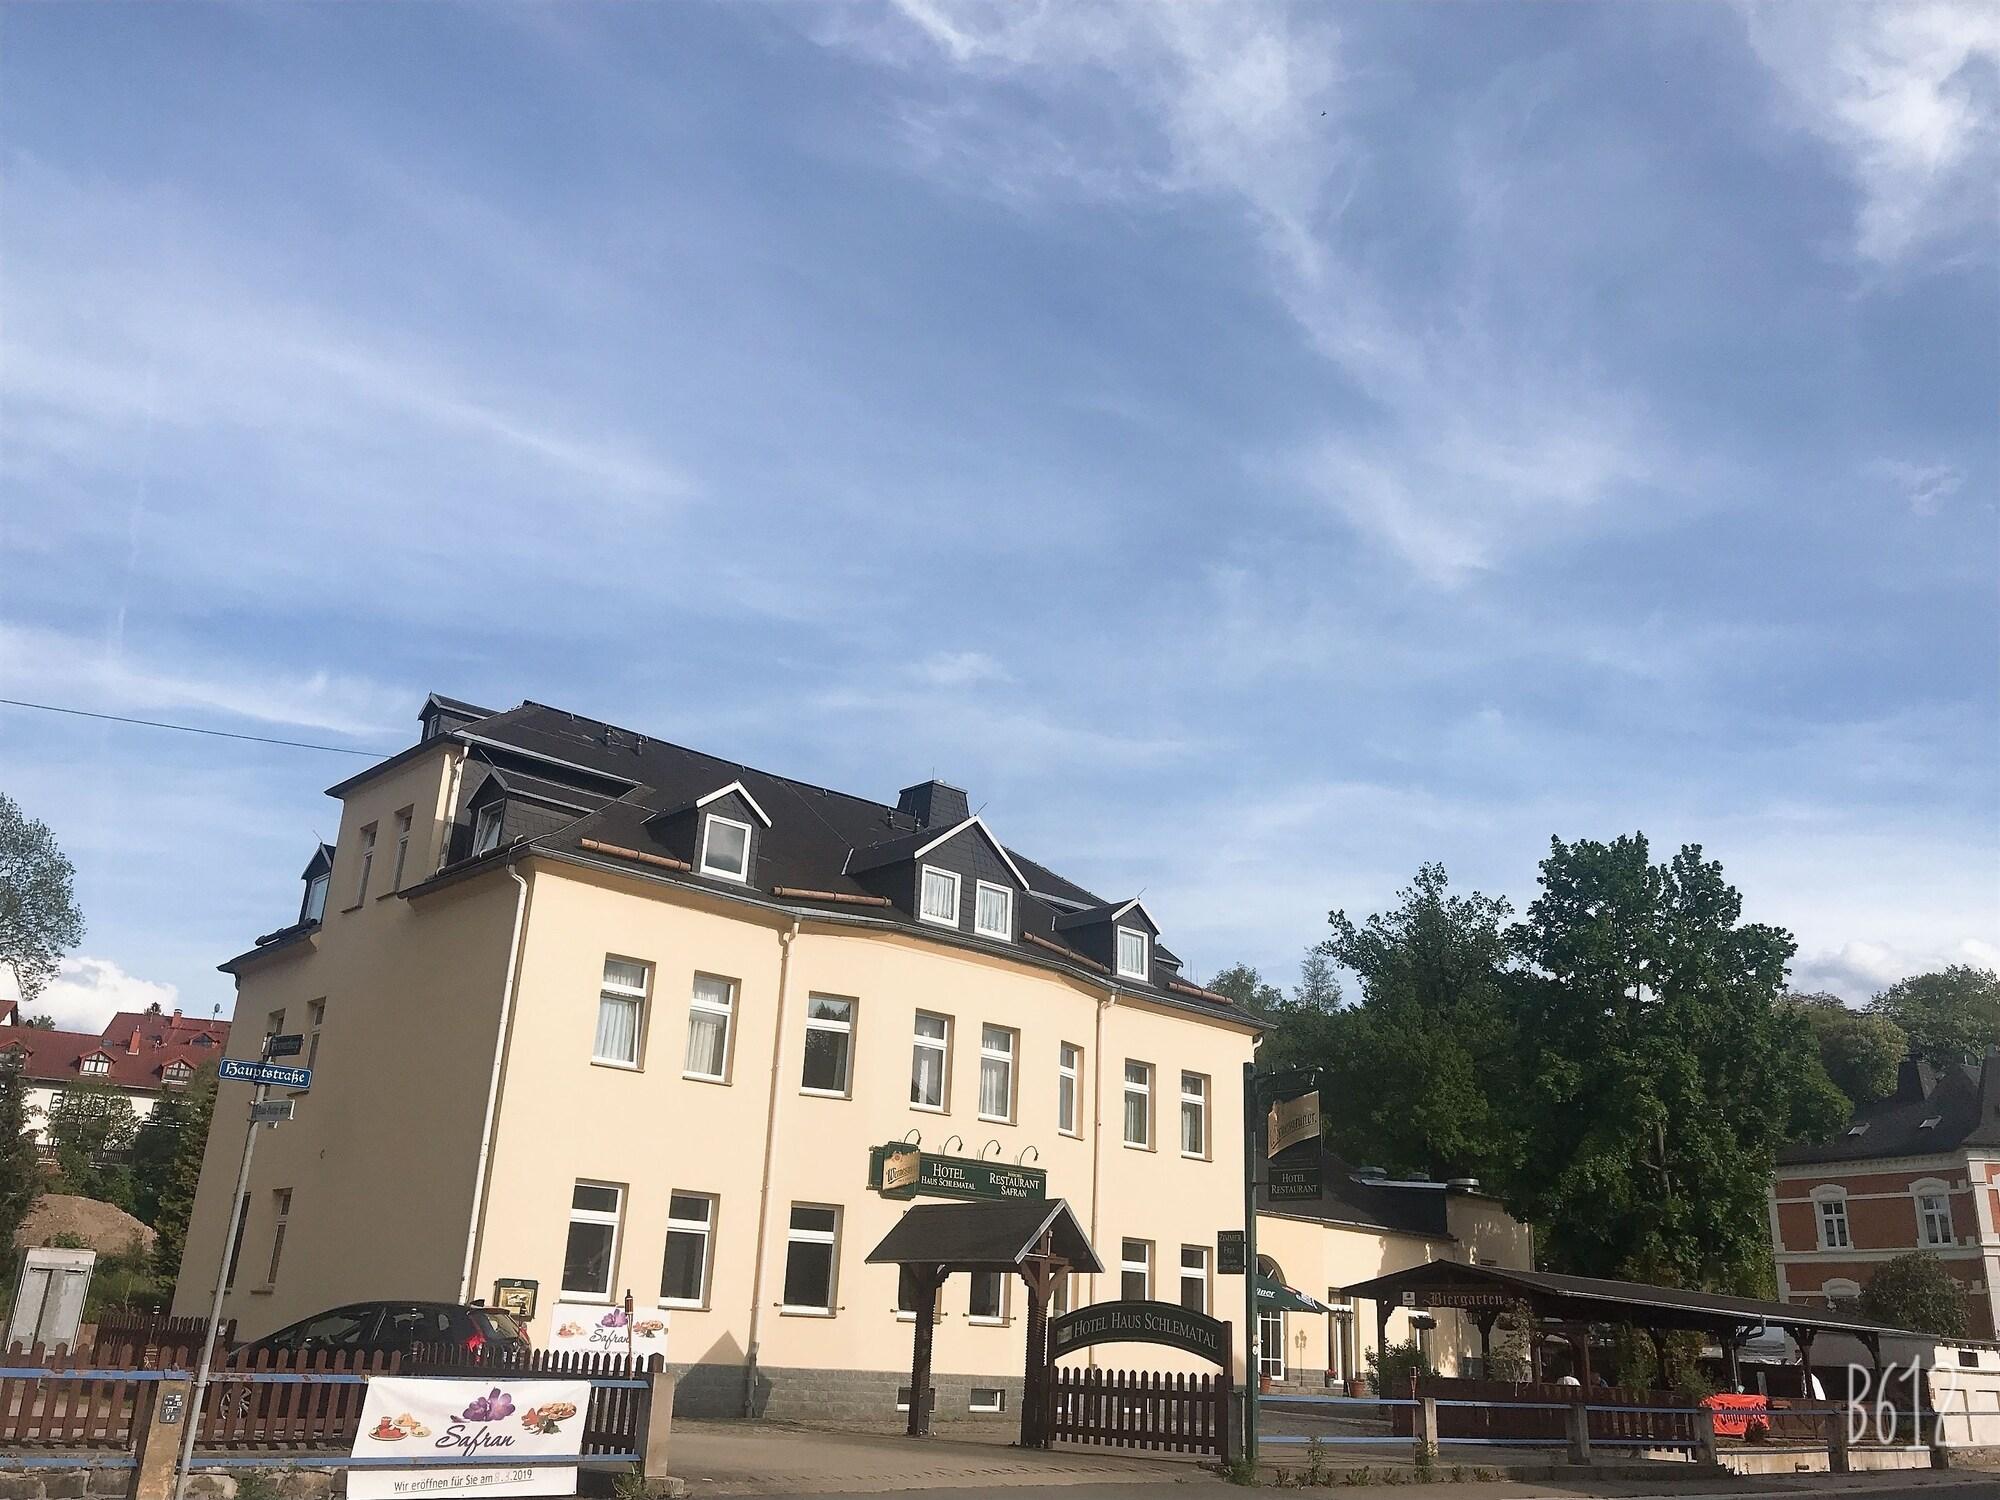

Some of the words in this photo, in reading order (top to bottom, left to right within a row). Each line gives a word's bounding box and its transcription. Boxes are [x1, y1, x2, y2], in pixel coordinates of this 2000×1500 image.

[225, 1062, 305, 1083] Hauptstraße
[932, 1163, 966, 1180] HOTEL
[1282, 1173, 1305, 1183] HOTEL
[989, 1172, 1040, 1190] RESTAURANT
[1271, 1184, 1318, 1195] RESTAURANT
[1000, 1185, 1028, 1198] SAFRAN
[1424, 1292, 1504, 1306] Biergarten
[1073, 1317, 1108, 1338] HOTEL
[1111, 1312, 1141, 1329] HAUS
[1144, 1313, 1218, 1349] SCHLEMATAL
[435, 1424, 516, 1456] Safran
[394, 1481, 409, 1492] Wir
[411, 1478, 448, 1491] eröffnen
[451, 1475, 463, 1486] für
[466, 1474, 479, 1486] Sie
[480, 1475, 493, 1484] am
